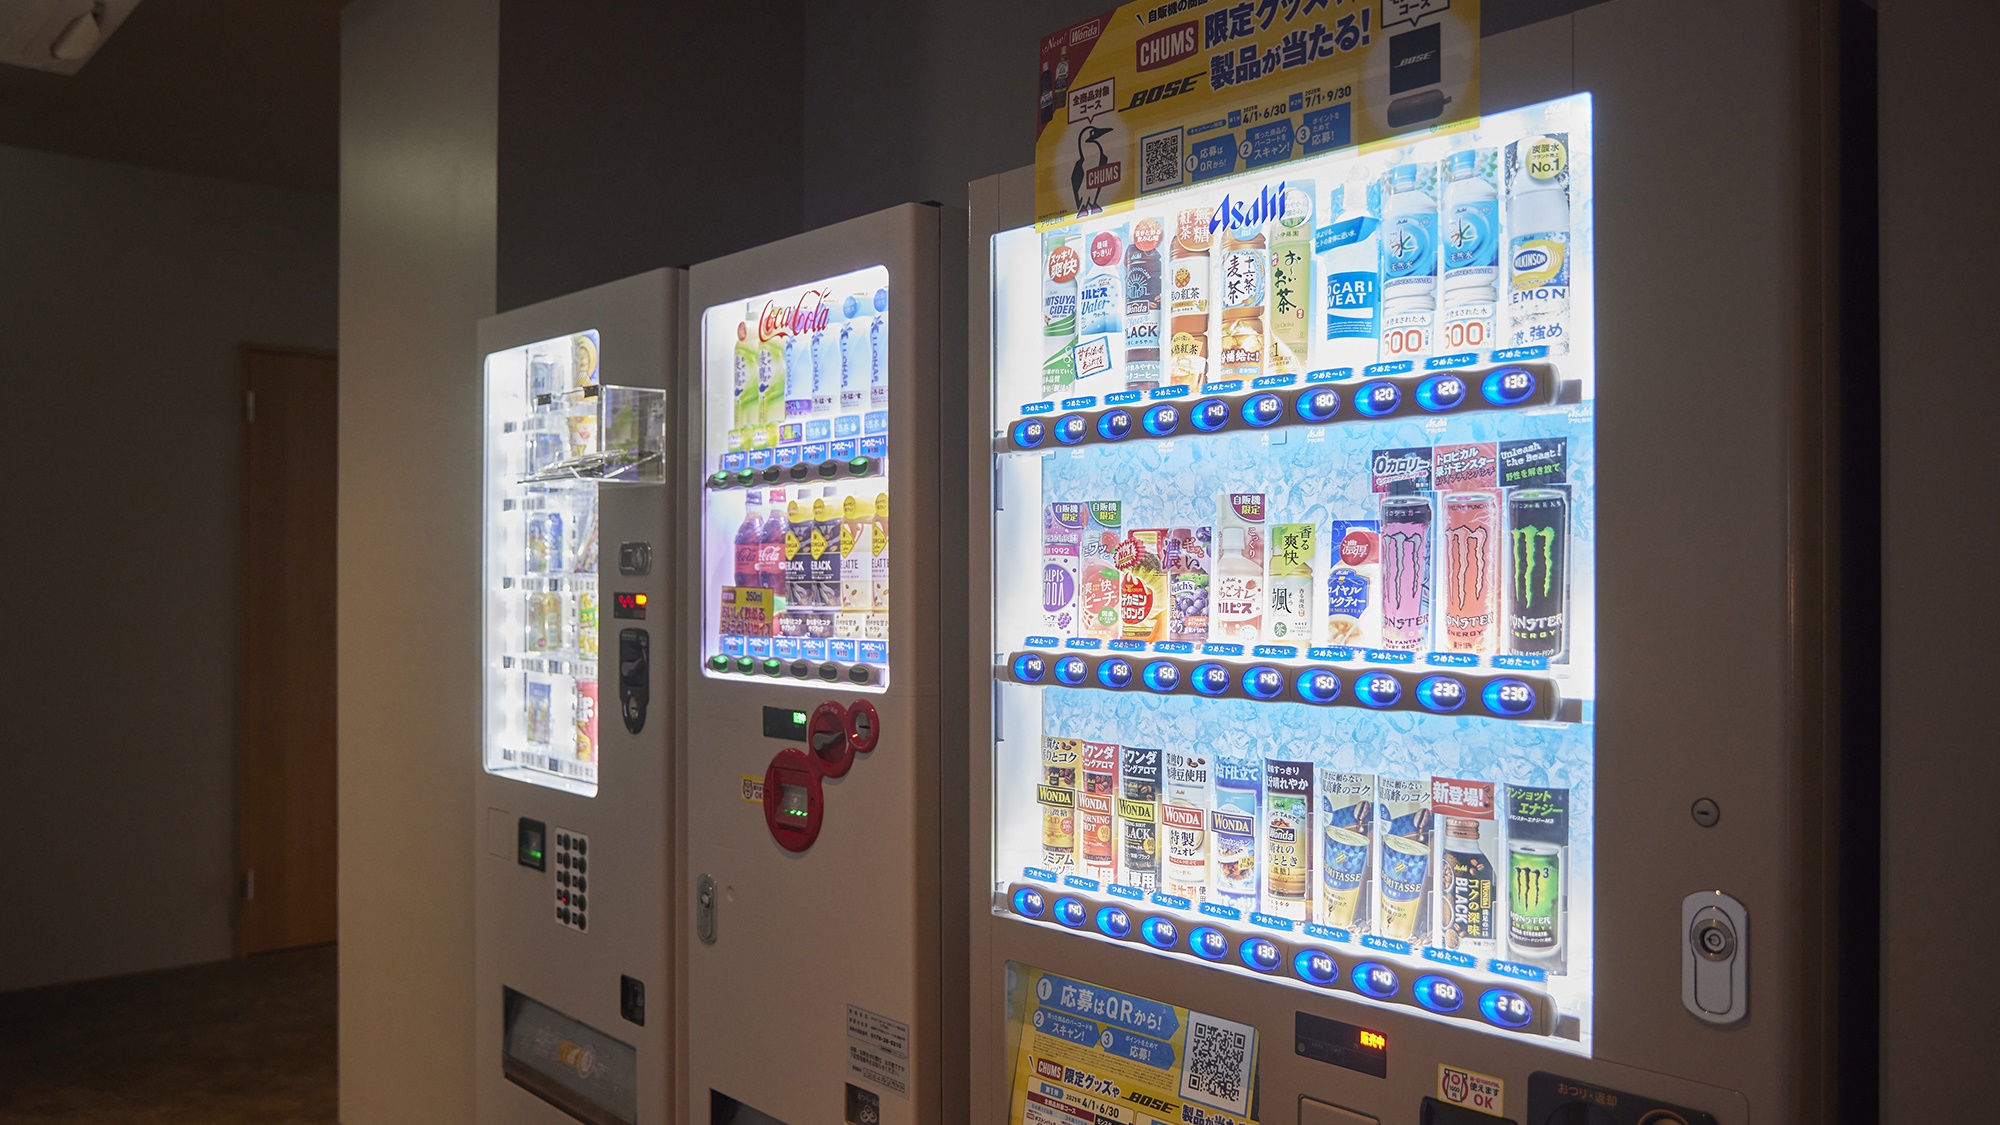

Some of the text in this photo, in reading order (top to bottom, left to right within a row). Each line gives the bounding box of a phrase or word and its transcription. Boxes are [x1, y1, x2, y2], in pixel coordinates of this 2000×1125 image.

[1071, 24, 1098, 44] Wonda
[1140, 26, 1194, 67] CHUMS
[1209, 7, 1370, 92] 製品が当たる!
[1394, 50, 1436, 69] BOSE
[1072, 86, 1110, 106] 全商品対象
[1118, 71, 1207, 113] BOSE
[1305, 85, 1352, 108] 7/1 9/30
[1080, 99, 1103, 115] コース
[1243, 103, 1287, 125] 4/1 6/30
[1311, 131, 1335, 147] 応募!
[1200, 145, 1224, 160] 応募は
[1254, 143, 1291, 160] スキャン!
[1532, 142, 1560, 154] 炭酸水
[1200, 159, 1227, 173] QRから!
[1531, 157, 1560, 174] No.1
[1088, 165, 1119, 187] CHUMS
[1209, 181, 1286, 235] Asahi
[1179, 212, 1193, 241] 紅茶
[1050, 248, 1074, 265] スッキリ
[1450, 251, 1474, 262] 天然水
[1514, 255, 1548, 268] WILKINSON
[1050, 259, 1078, 280] 爽快
[1243, 256, 1256, 294] 十六茶
[1390, 261, 1413, 272] 天然水
[1227, 255, 1244, 304] 麦茶
[1508, 288, 1566, 306] LEMON
[1050, 304, 1075, 315] CIDER
[1437, 381, 1459, 395] 120
[1503, 374, 1527, 388] 130
[1316, 394, 1334, 407] 180
[1374, 387, 1394, 400] 120
[1208, 405, 1224, 416] 140
[1260, 399, 1277, 411] 160
[1112, 415, 1127, 426] 170
[1158, 410, 1174, 422] 150
[1069, 420, 1083, 431] 160
[1436, 447, 1479, 466] トロピカル
[1501, 441, 1542, 460] Unleash
[1506, 443, 1562, 467] the Beast!
[1375, 456, 1430, 476] 0カロリー
[1435, 457, 1496, 477] 果汁モンスター
[1505, 462, 1561, 482] 野性を解き放て
[1055, 503, 1078, 513] 自販機
[1092, 502, 1117, 513] 自販機
[1233, 495, 1261, 505] 自販機
[1061, 512, 1078, 522] 限定
[1099, 511, 1117, 521] 限定
[1241, 505, 1261, 515] 限定
[1298, 525, 1311, 551] 香る
[1283, 533, 1299, 566] 爽快
[1085, 589, 1118, 609] ピーチ
[1028, 660, 1041, 671] 140
[1069, 662, 1083, 674] 150
[1113, 664, 1127, 676] 150
[1159, 667, 1174, 679] 150
[1208, 670, 1225, 682] 150
[1260, 672, 1278, 685] 140
[1316, 676, 1334, 689] 150
[1371, 679, 1394, 693] 230
[1433, 682, 1460, 697] 230
[1500, 685, 1529, 702] 230
[1038, 788, 1072, 804] WONDA
[1078, 791, 1109, 811] WONDA
[1433, 781, 1485, 807] 新登場!
[1119, 798, 1151, 818] WONDA
[1164, 806, 1200, 826] WONDA
[1518, 800, 1564, 816] エナジー
[1213, 813, 1250, 832] WONDA
[1170, 829, 1195, 847] 特製
[1542, 868, 1550, 880] 3
[1028, 894, 1041, 906] 140
[1455, 876, 1470, 925] BLACK
[1481, 880, 1490, 908] WONDA
[1068, 903, 1082, 915] 140
[1468, 878, 1481, 936] コクの深味
[1111, 914, 1126, 926] 140
[1157, 923, 1173, 936] 140
[1206, 934, 1223, 947] 130
[1257, 944, 1275, 959] 130
[1313, 957, 1332, 972] 140
[1372, 969, 1392, 986] 140
[1434, 982, 1456, 1000] 160
[1060, 984, 1163, 1031] 応募はQRから!
[1497, 995, 1526, 1016] 210
[1051, 1022, 1085, 1042] スキャン!
[1360, 1030, 1385, 1050] 販売中
[1129, 1044, 1152, 1061] 応募!
[1038, 1060, 1062, 1079] CHUMS
[1063, 1067, 1121, 1100] 限定グッズや
[1469, 1082, 1500, 1097] 使えます
[1121, 1090, 1180, 1115] BOSE
[1473, 1093, 1494, 1110] OK
[1557, 1082, 1618, 1107] おつり・返却
[1082, 1096, 1096, 1110] 4/1
[1099, 1101, 1120, 1119] 6/30
